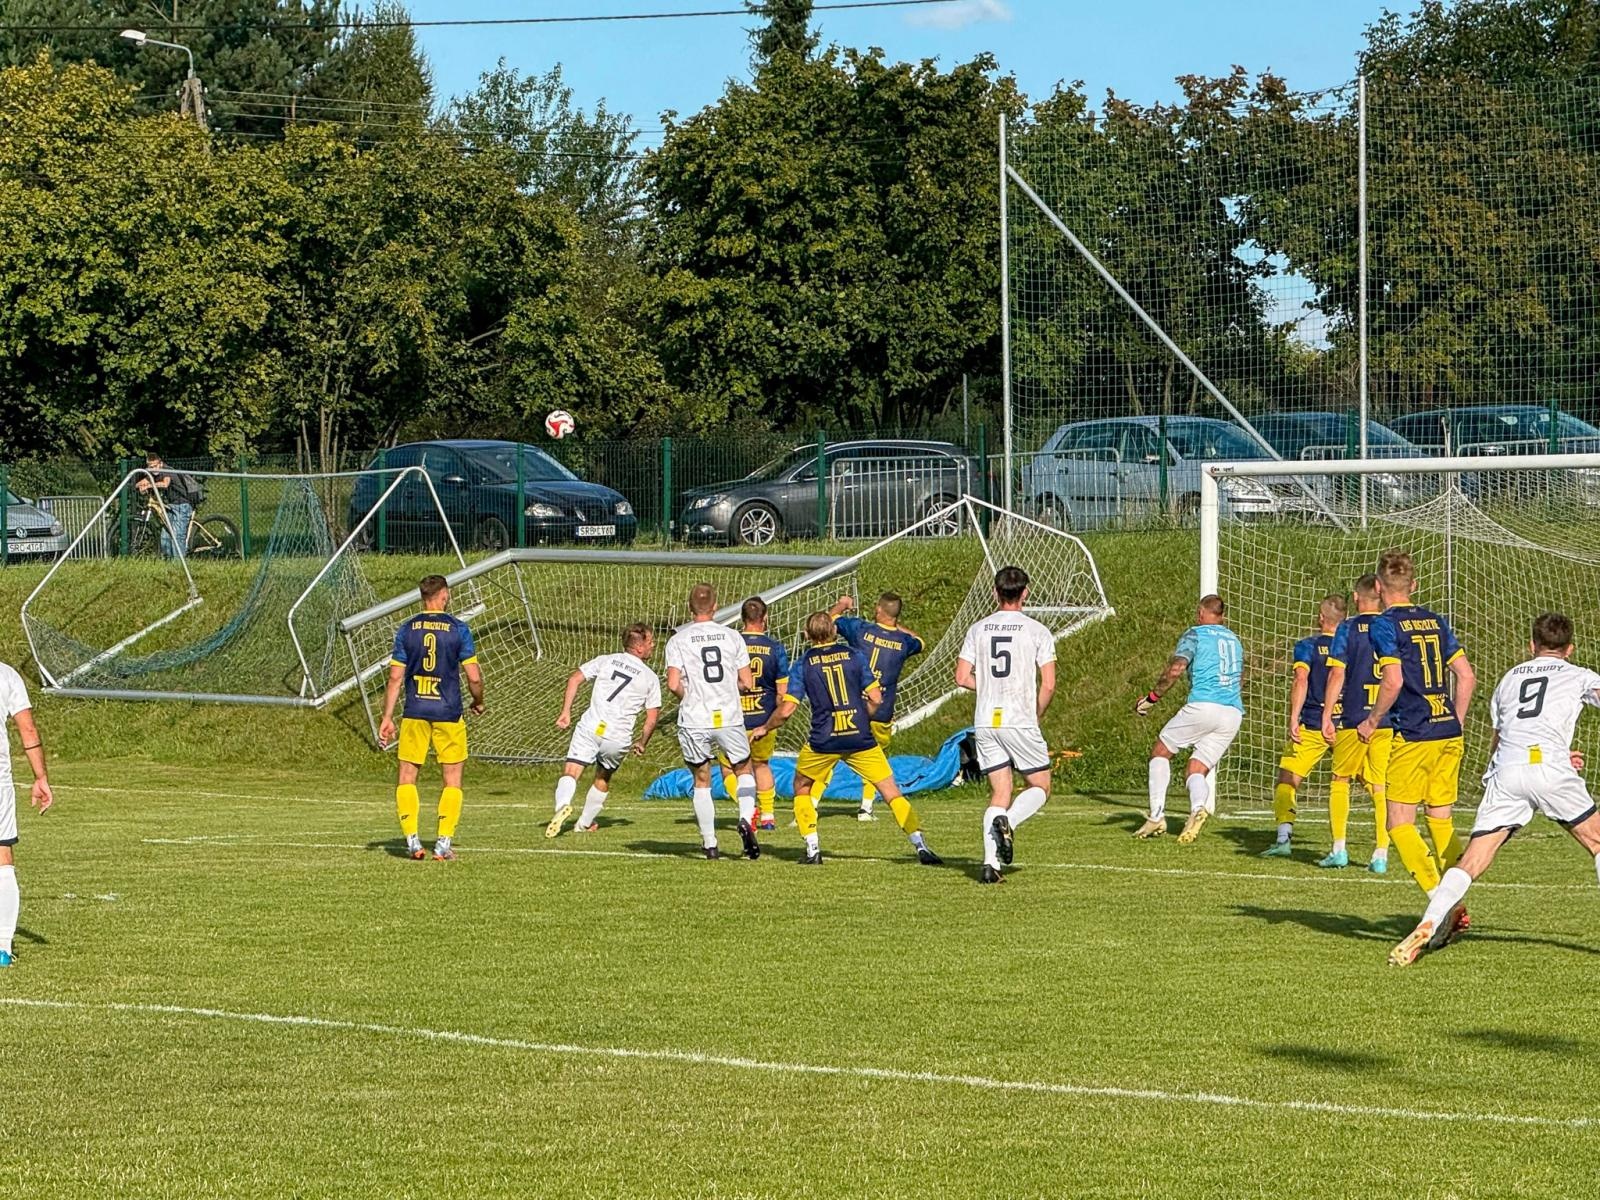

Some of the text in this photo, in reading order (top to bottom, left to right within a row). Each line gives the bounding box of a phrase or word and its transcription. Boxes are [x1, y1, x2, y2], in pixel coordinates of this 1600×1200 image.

[423, 632, 436, 672] 3
[691, 633, 726, 643] BUK RUDY
[991, 636, 1012, 678] 5
[1217, 639, 1238, 674] 91
[701, 646, 724, 684] 8
[1512, 665, 1564, 675] BUK RUDY
[606, 670, 633, 702] 7
[822, 663, 849, 706] 11
[1516, 676, 1549, 719] 9
